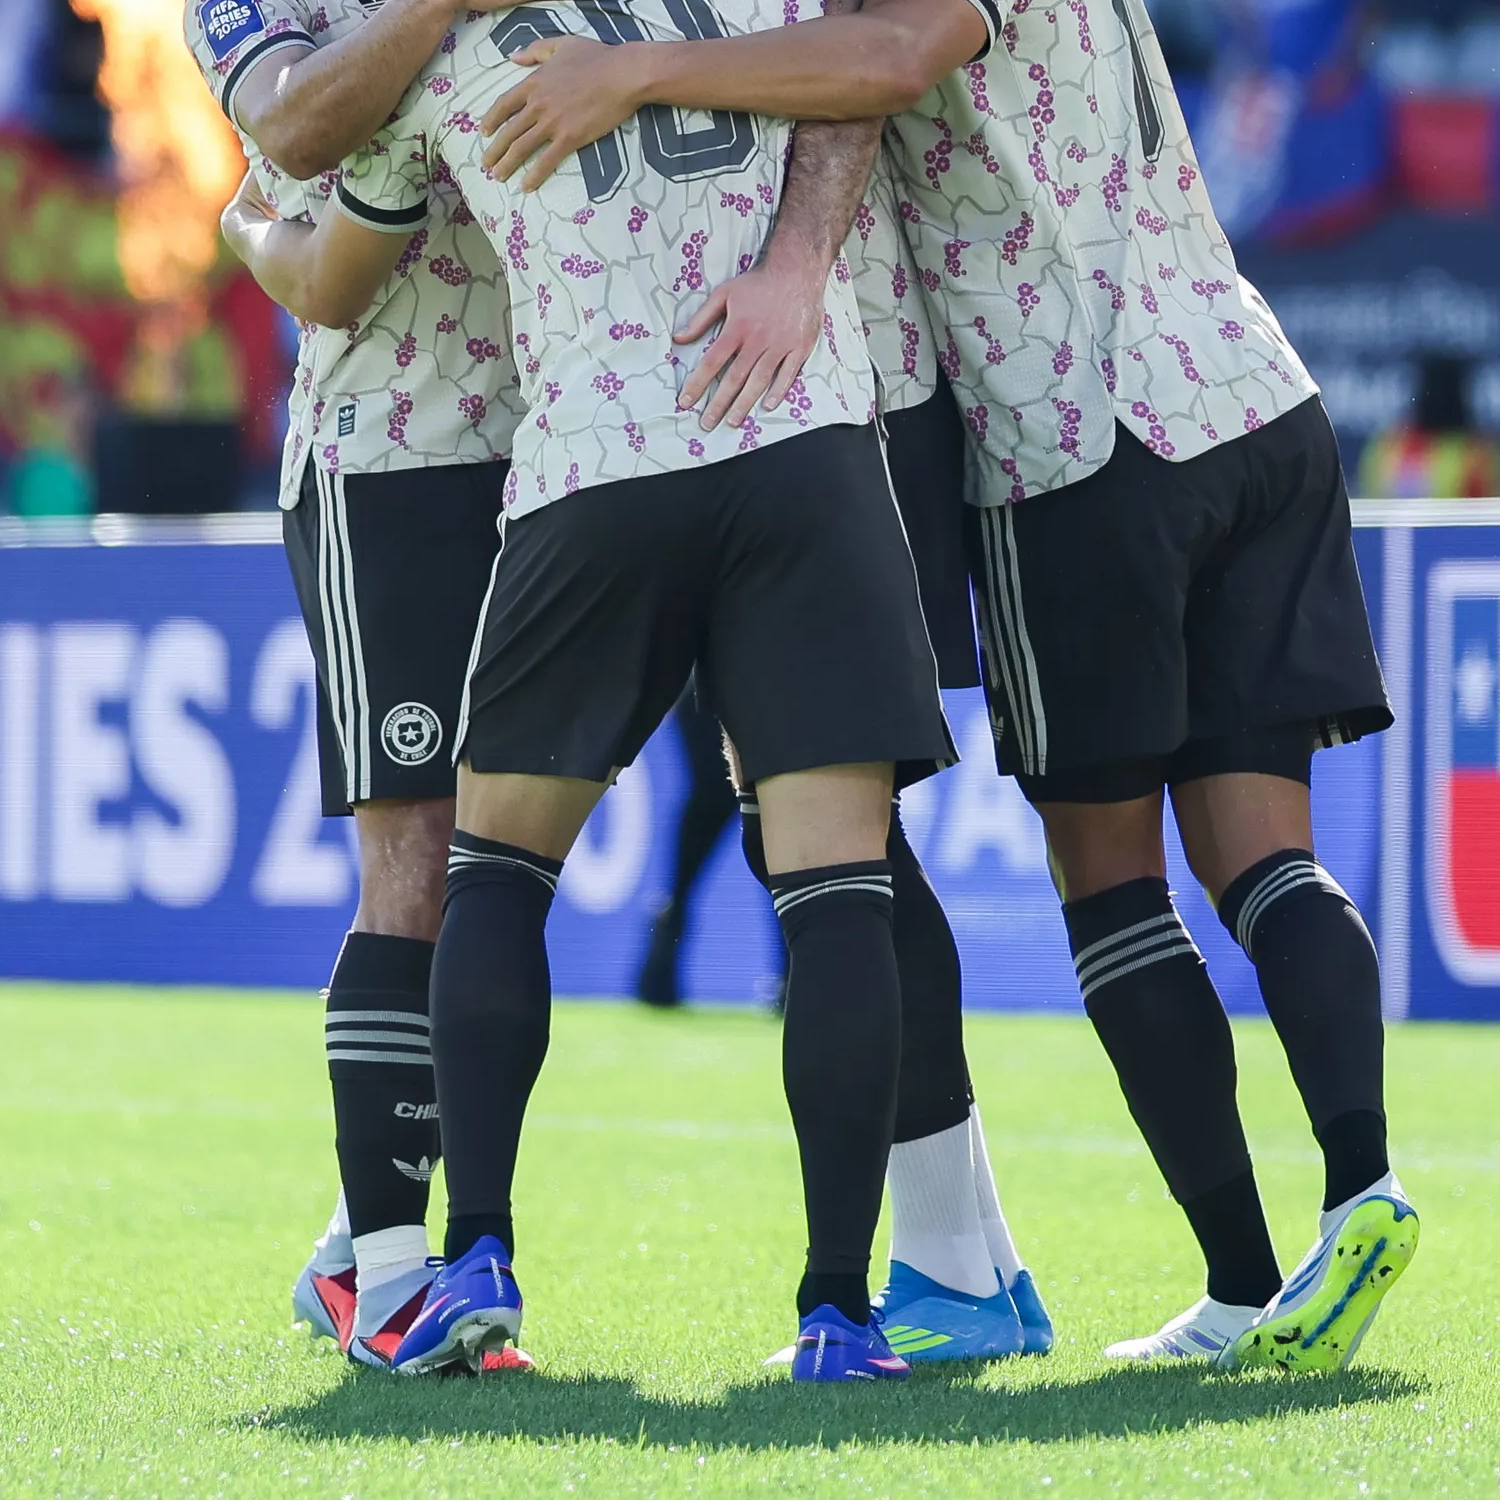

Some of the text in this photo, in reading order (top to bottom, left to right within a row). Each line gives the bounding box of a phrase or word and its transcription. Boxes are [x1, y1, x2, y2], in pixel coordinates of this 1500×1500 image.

[208, 5, 251, 35] SERIES
[210, 0, 239, 20] FIFA
[215, 17, 249, 41] 2026
[394, 1102, 440, 1119] CHIL
